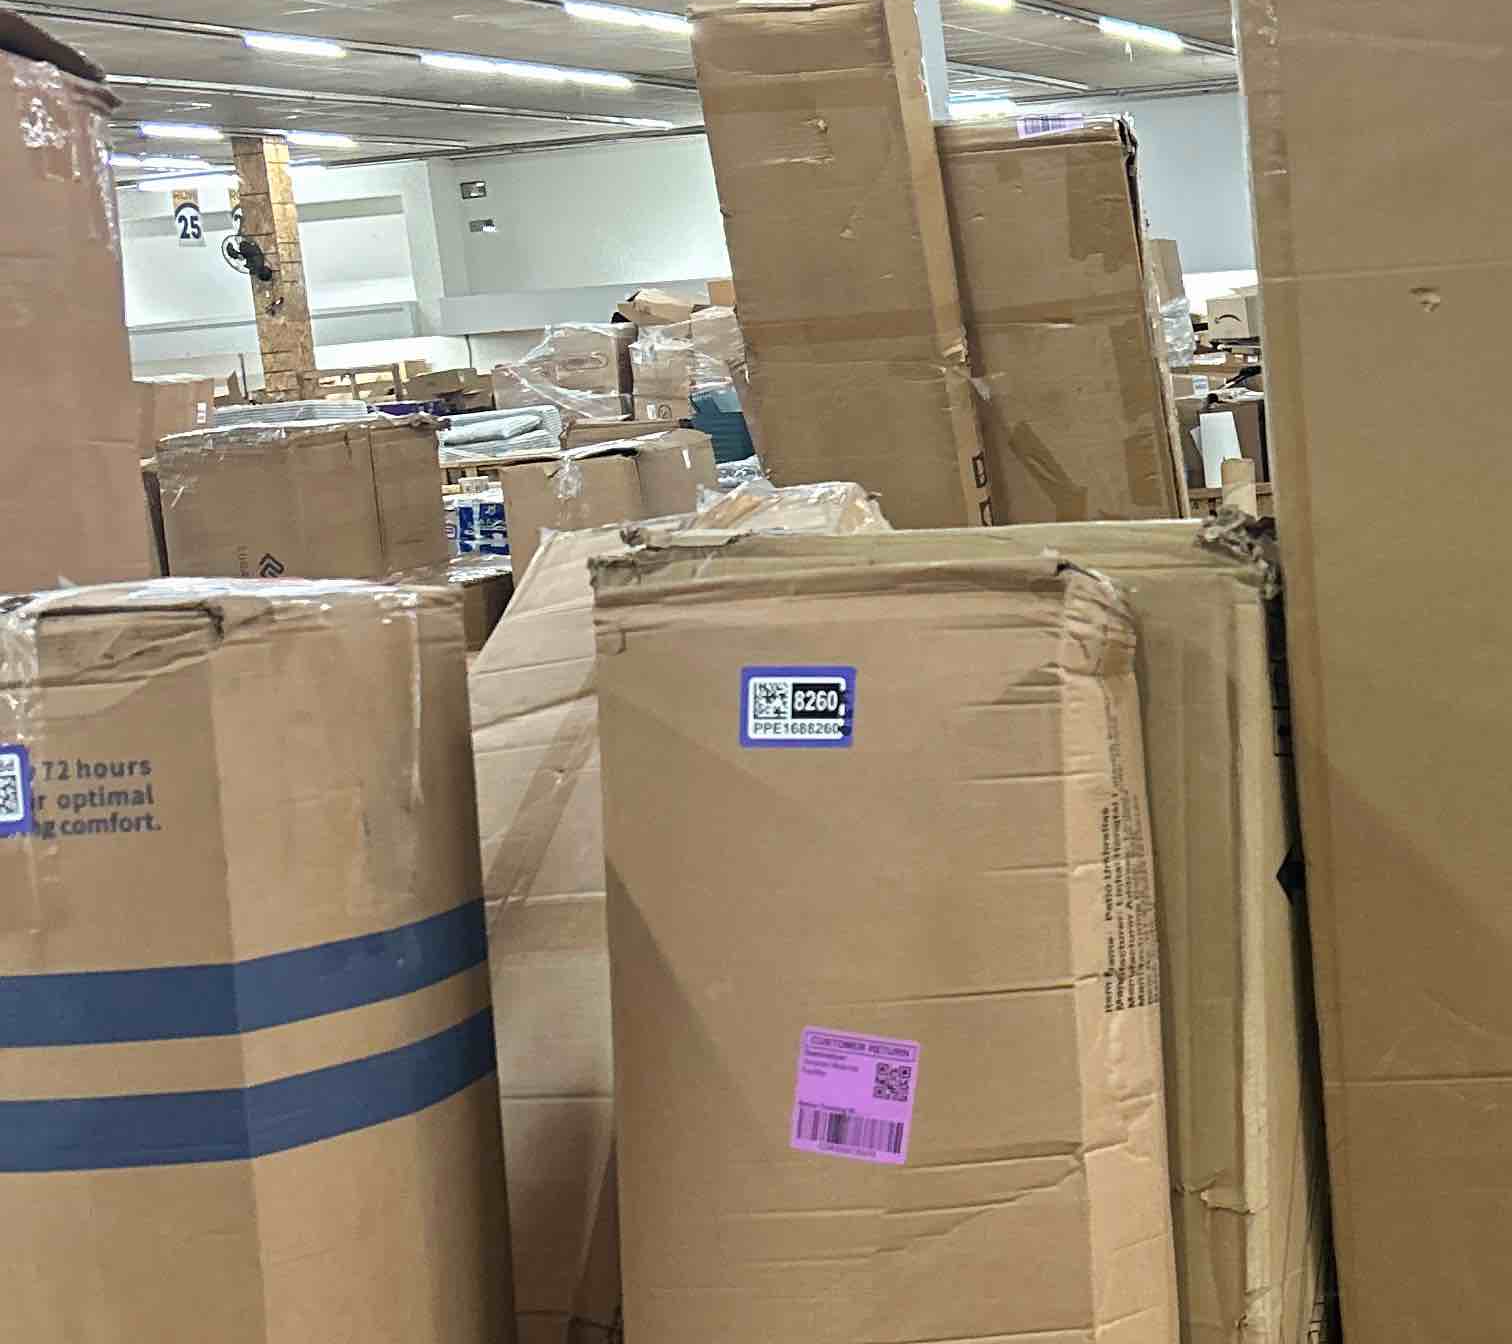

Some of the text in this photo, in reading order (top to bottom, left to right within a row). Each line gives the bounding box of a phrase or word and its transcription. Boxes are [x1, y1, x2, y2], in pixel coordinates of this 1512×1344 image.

[178, 214, 202, 239] 25
[793, 690, 838, 711] 8260
[42, 760, 70, 781] 72
[76, 757, 152, 779] hours
[57, 784, 154, 813] optimal
[59, 811, 163, 836] comfort.
